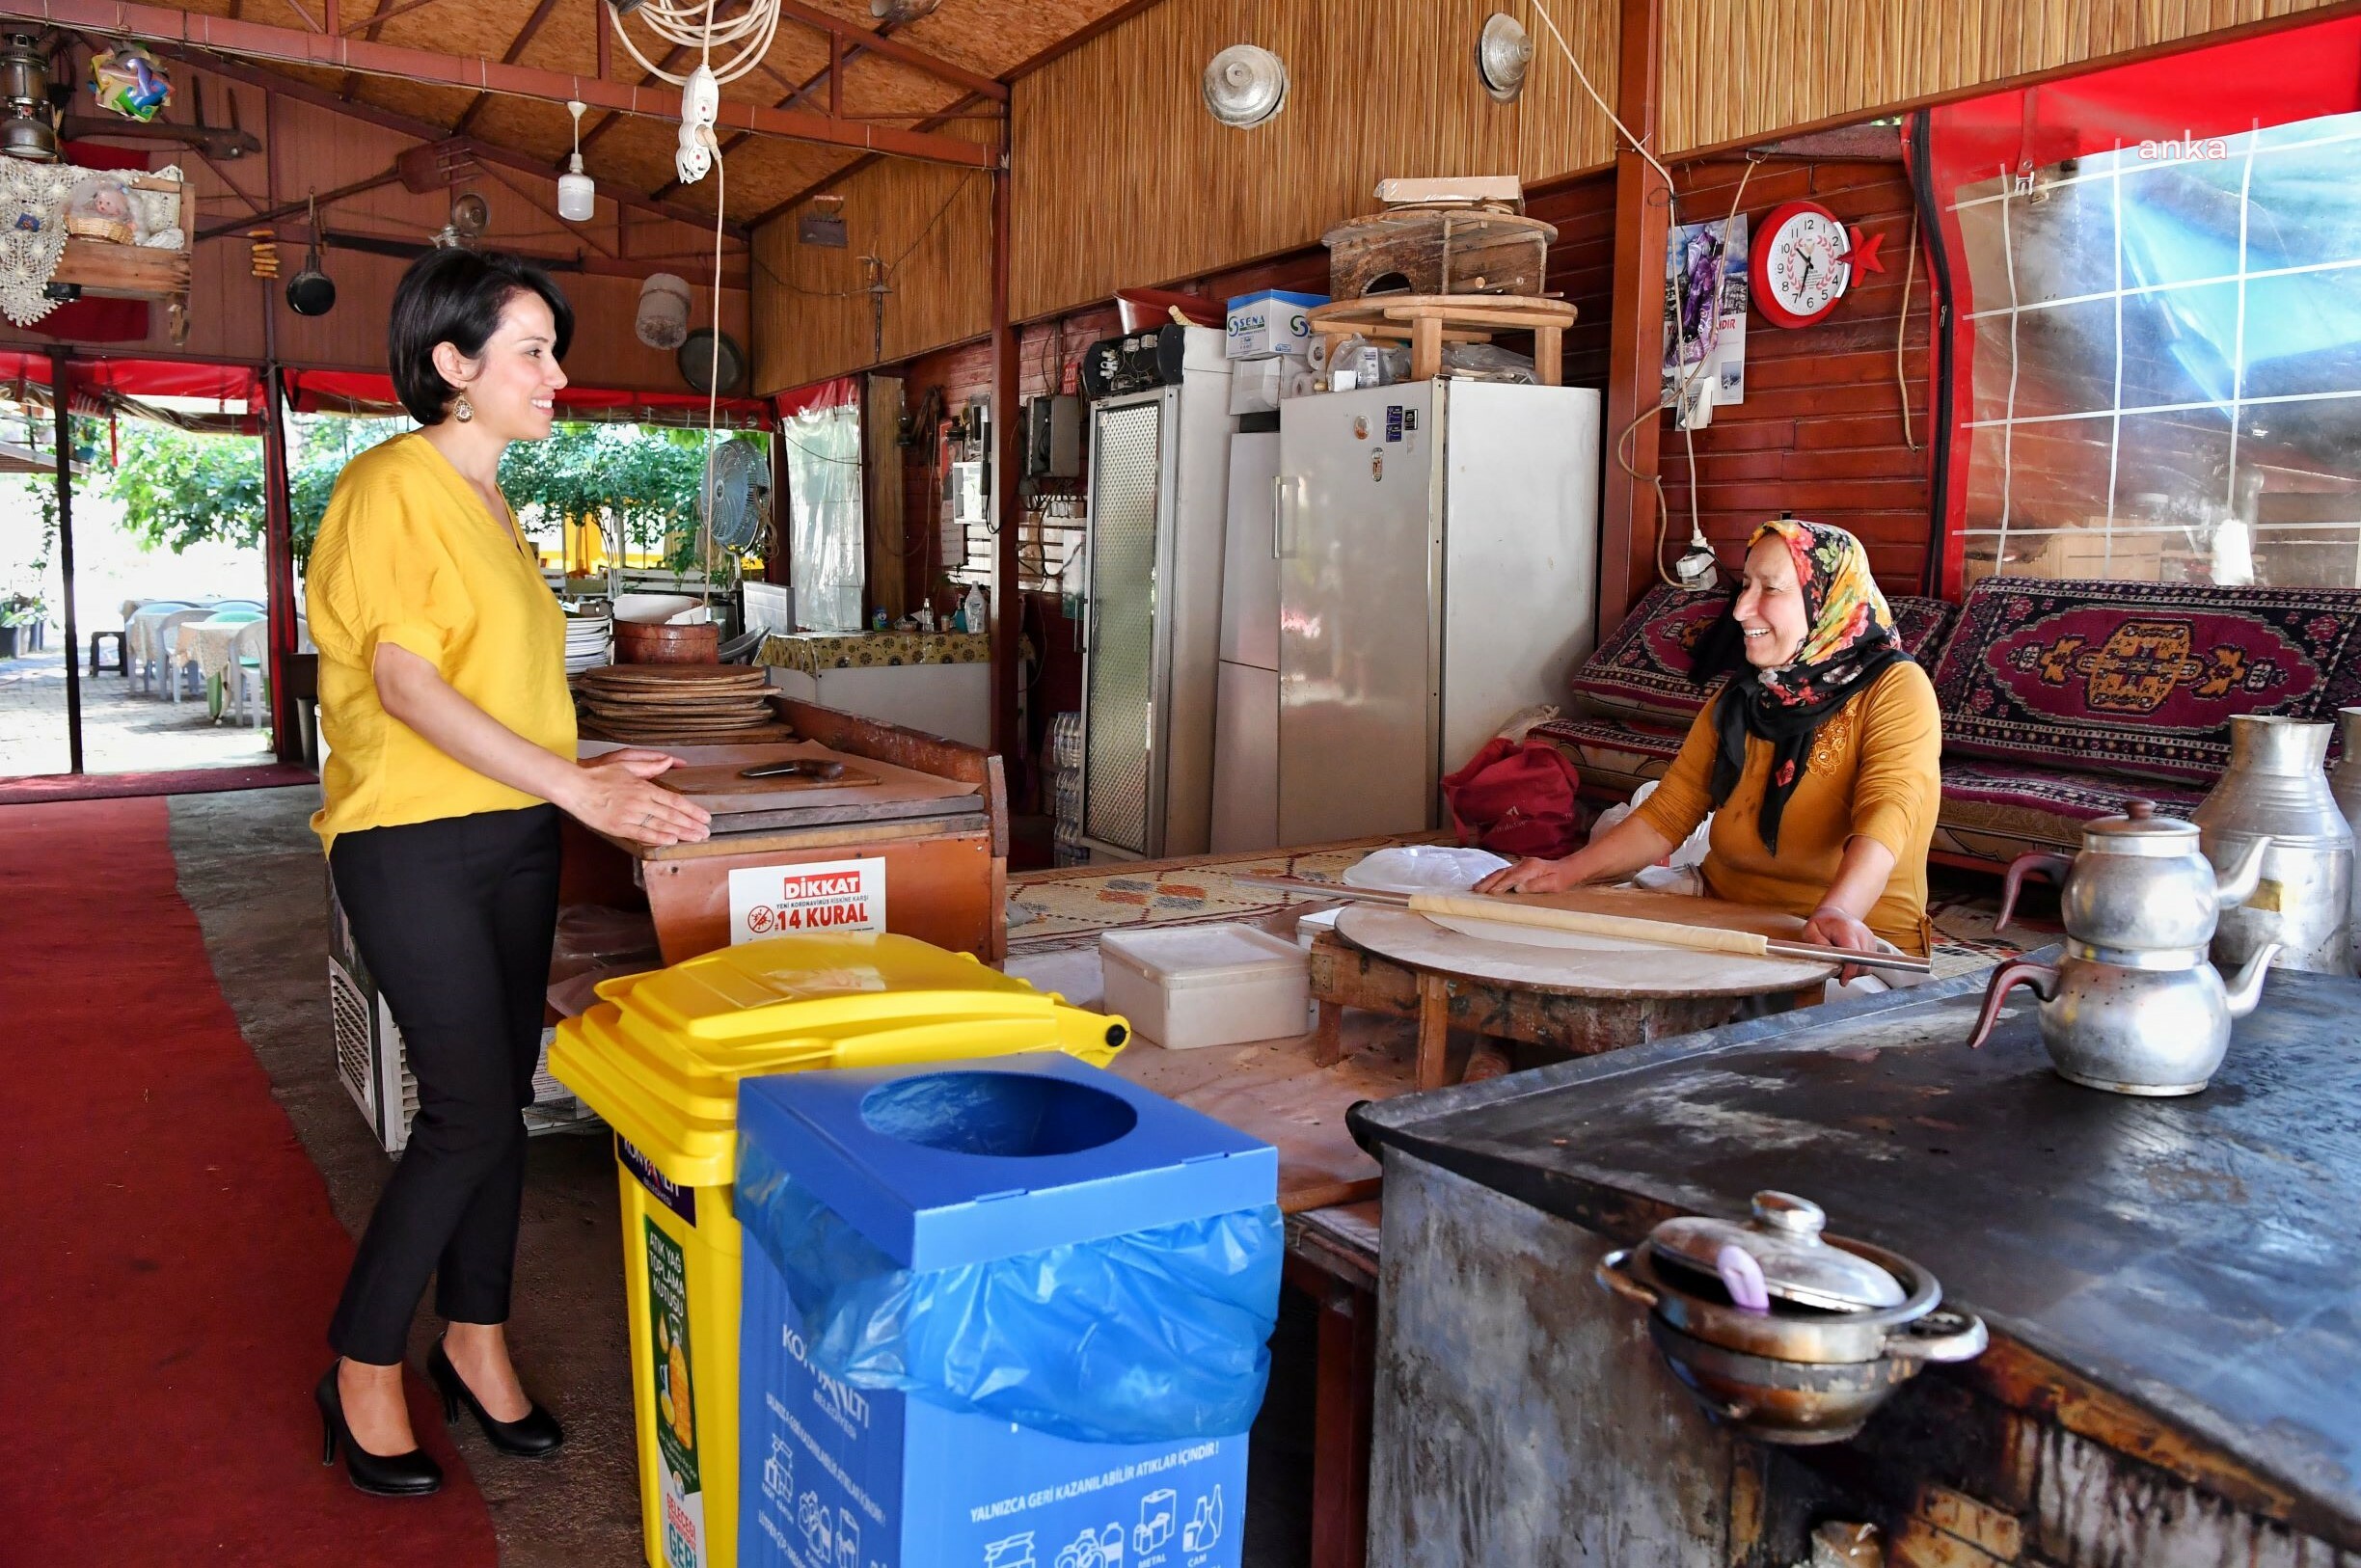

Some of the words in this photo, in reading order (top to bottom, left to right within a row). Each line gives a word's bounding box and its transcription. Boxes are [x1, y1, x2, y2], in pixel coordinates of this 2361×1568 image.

[1804, 219, 1814, 230] 12
[1791, 228, 1799, 238] 11
[1832, 236, 1839, 247] 2
[1781, 243, 1790, 254] 10
[1778, 263, 1784, 274] 9
[1832, 275, 1838, 285] 4
[1781, 282, 1789, 291] 8
[1792, 293, 1799, 304] 7
[1821, 289, 1829, 300] 5
[1806, 297, 1814, 308] 6
[1239, 314, 1265, 328] SENA
[1065, 367, 1076, 382] 220
[785, 877, 859, 899] DİKKAT
[807, 903, 868, 928] KURAL
[665, 1245, 682, 1274] YAĞ
[649, 1250, 686, 1299] TOPLAMA
[653, 1274, 684, 1317] KUTUSU
[970, 1496, 1026, 1523] YALNIZCA
[1027, 1485, 1054, 1508] GERİ
[1055, 1464, 1135, 1500] KAZANILABİLİR
[1136, 1452, 1177, 1477] ATIKLAR
[1138, 1554, 1166, 1568] METAL
